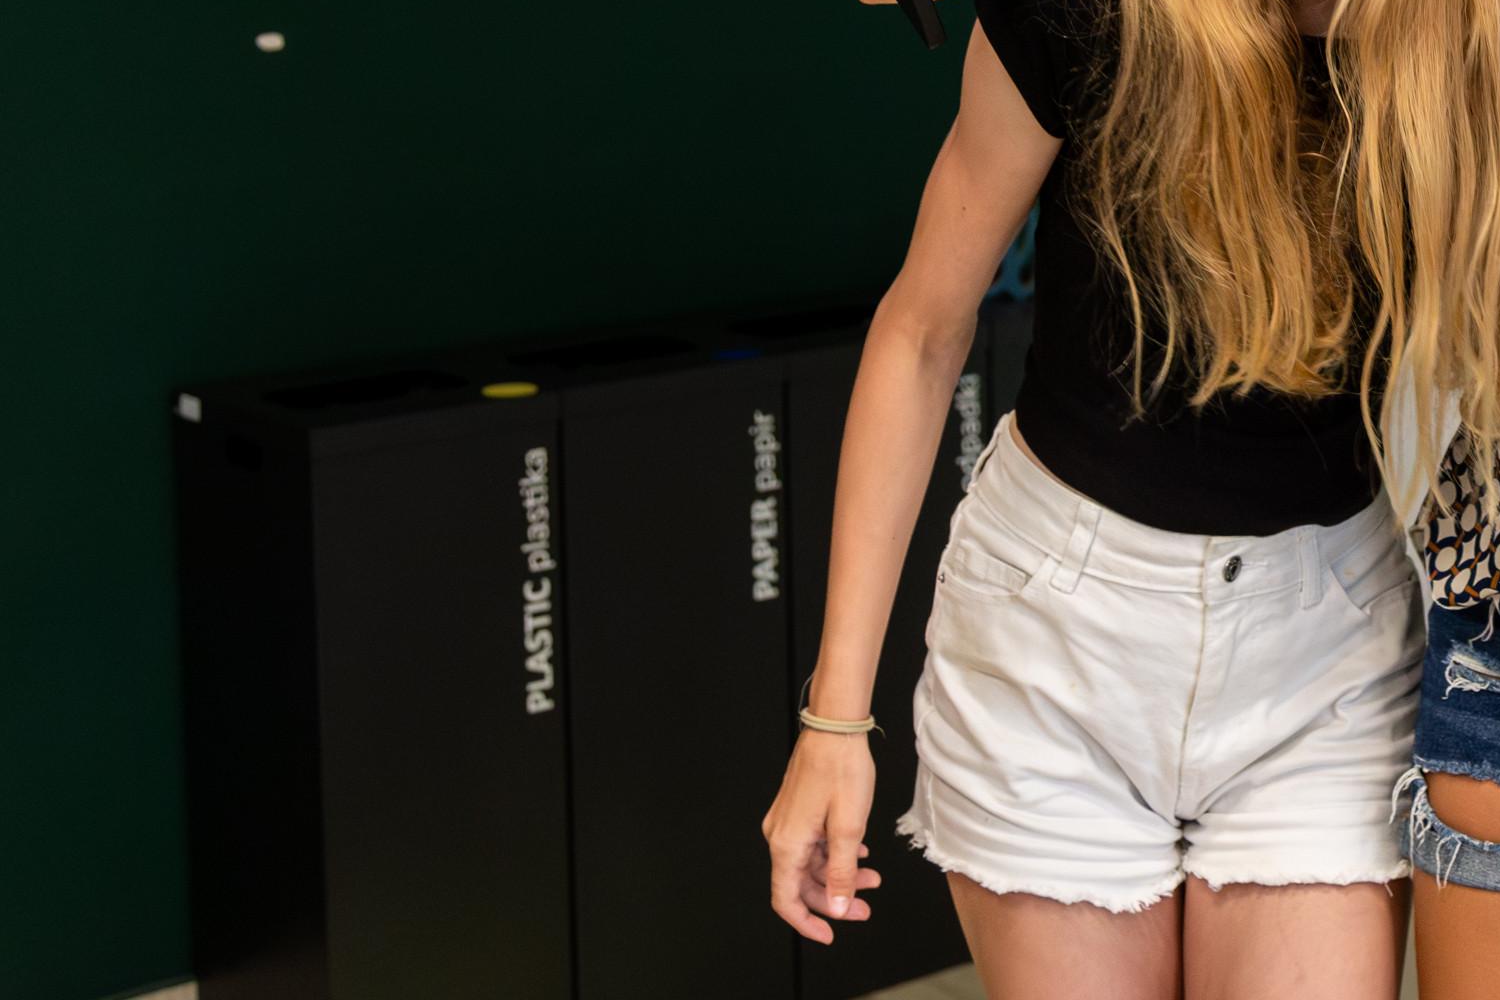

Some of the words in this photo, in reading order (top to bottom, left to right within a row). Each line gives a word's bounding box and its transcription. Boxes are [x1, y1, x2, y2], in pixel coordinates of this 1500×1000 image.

[518, 446, 557, 572] plastika
[748, 409, 782, 493] papir
[750, 495, 780, 601] PAPER
[523, 577, 555, 714] PLASTIC
